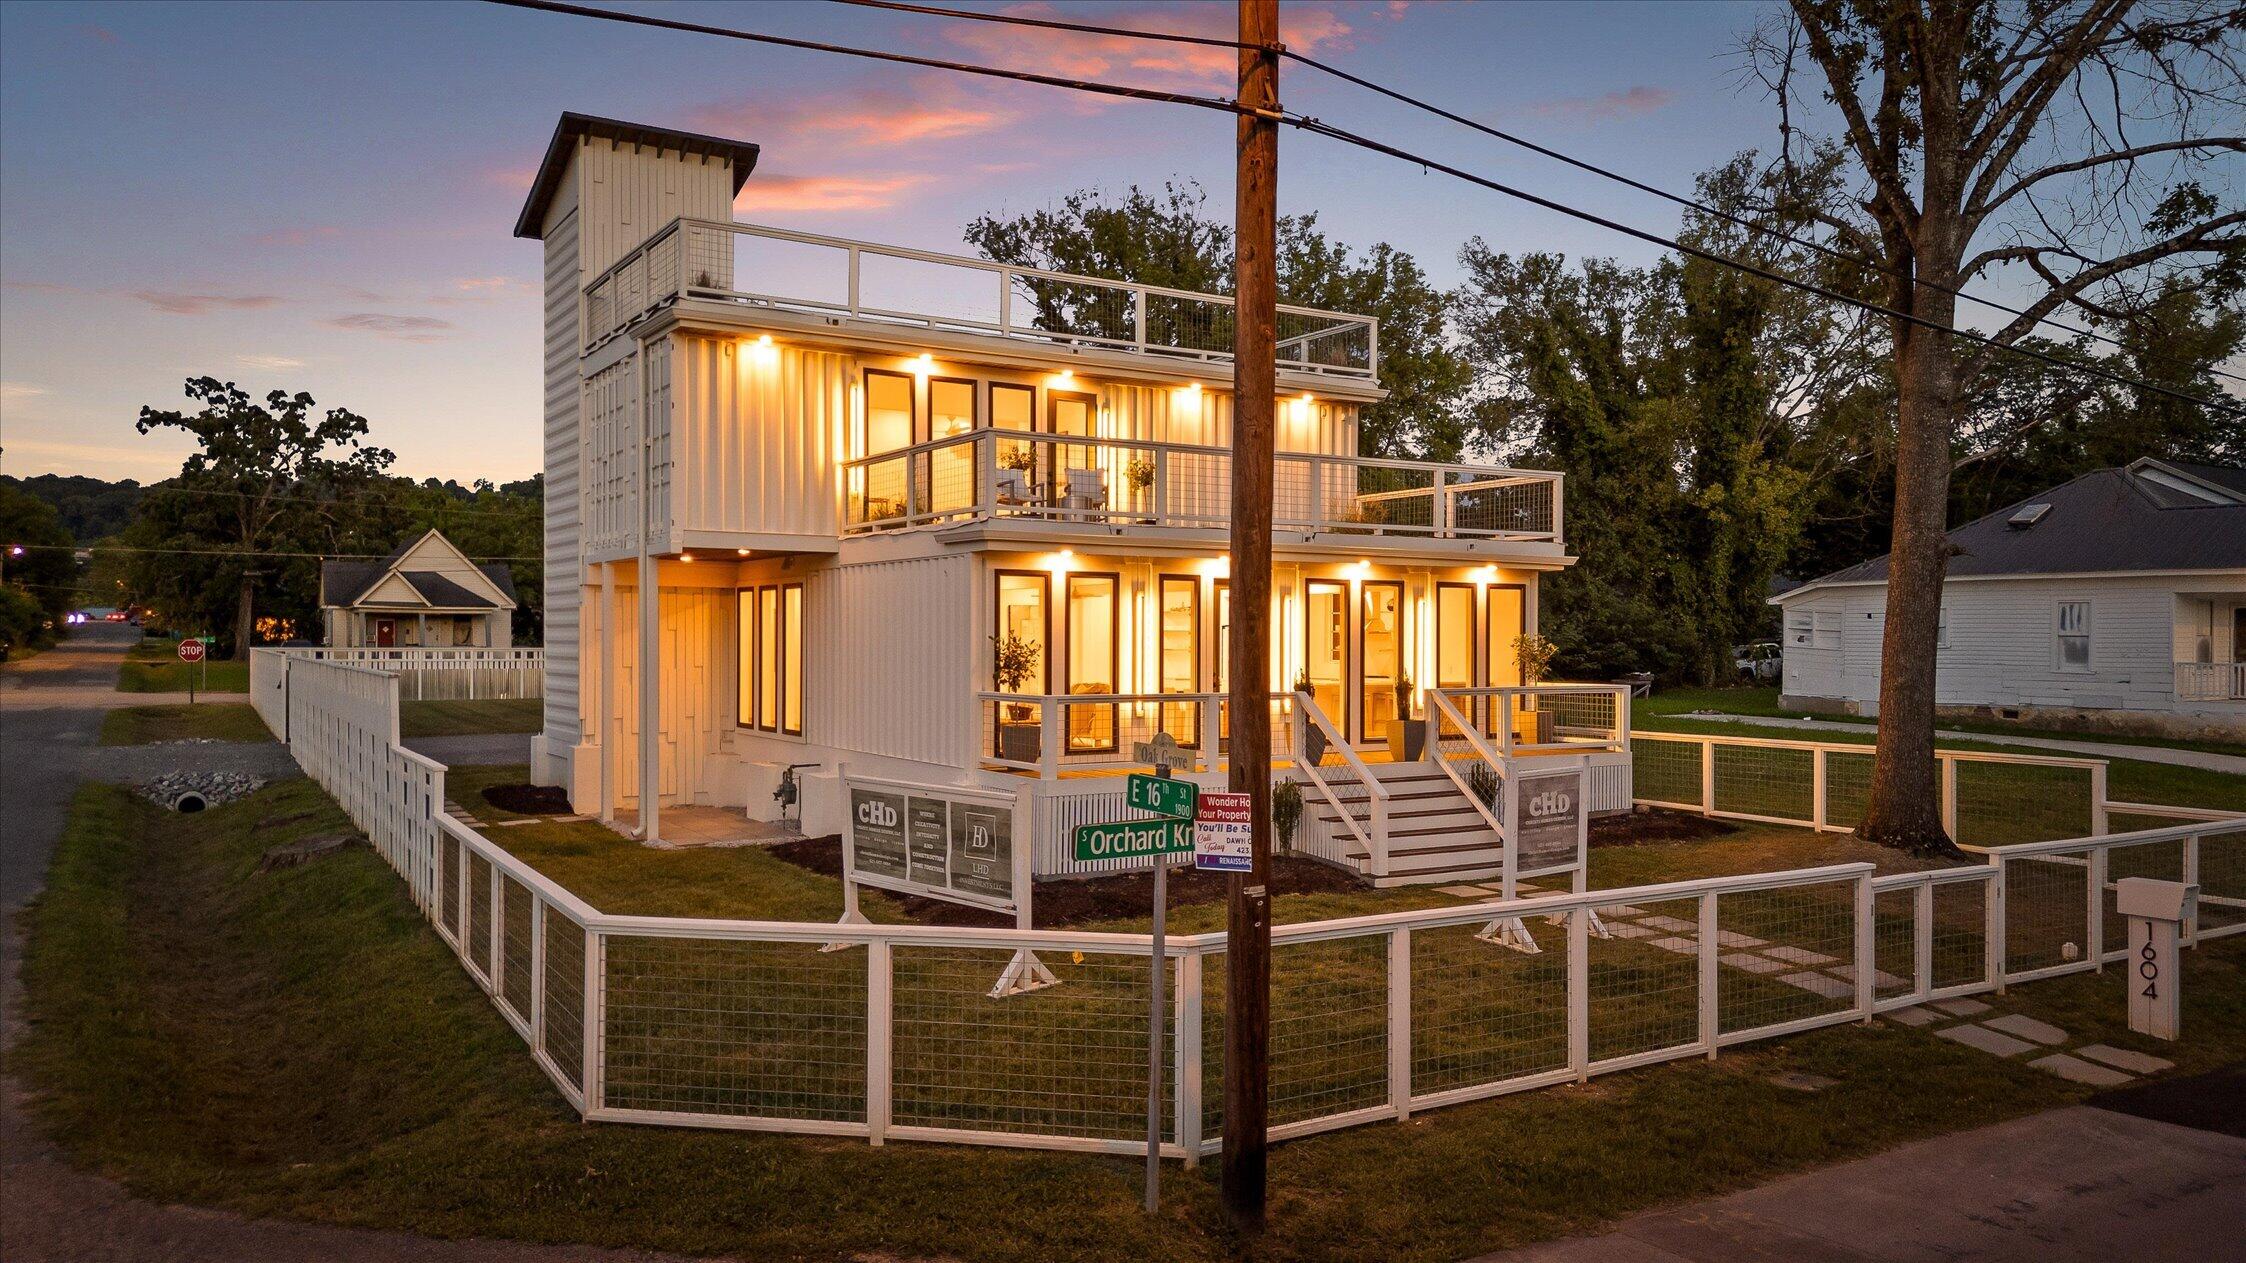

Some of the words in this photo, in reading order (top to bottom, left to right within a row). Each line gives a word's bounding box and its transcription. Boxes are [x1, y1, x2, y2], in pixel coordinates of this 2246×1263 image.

[181, 646, 202, 655] STOP
[1141, 746, 1158, 763] Oak
[1161, 749, 1187, 769] Grove
[1132, 779, 1140, 802] E
[1179, 787, 1187, 799] St
[1207, 796, 1239, 807] Wonder
[1529, 791, 1570, 816] CHD
[858, 801, 897, 827] CHD
[1175, 803, 1190, 817] 1900
[1198, 808, 1216, 818] Your
[1217, 809, 1251, 821] Property
[1198, 823, 1223, 833] You'll
[1226, 825, 1238, 833] Be
[1082, 830, 1088, 842] S
[1091, 822, 1166, 854] Orchard
[1197, 833, 1212, 844] Call
[1204, 842, 1225, 852] Today
[972, 863, 989, 875] LHD
[2140, 922, 2158, 999] 1604
